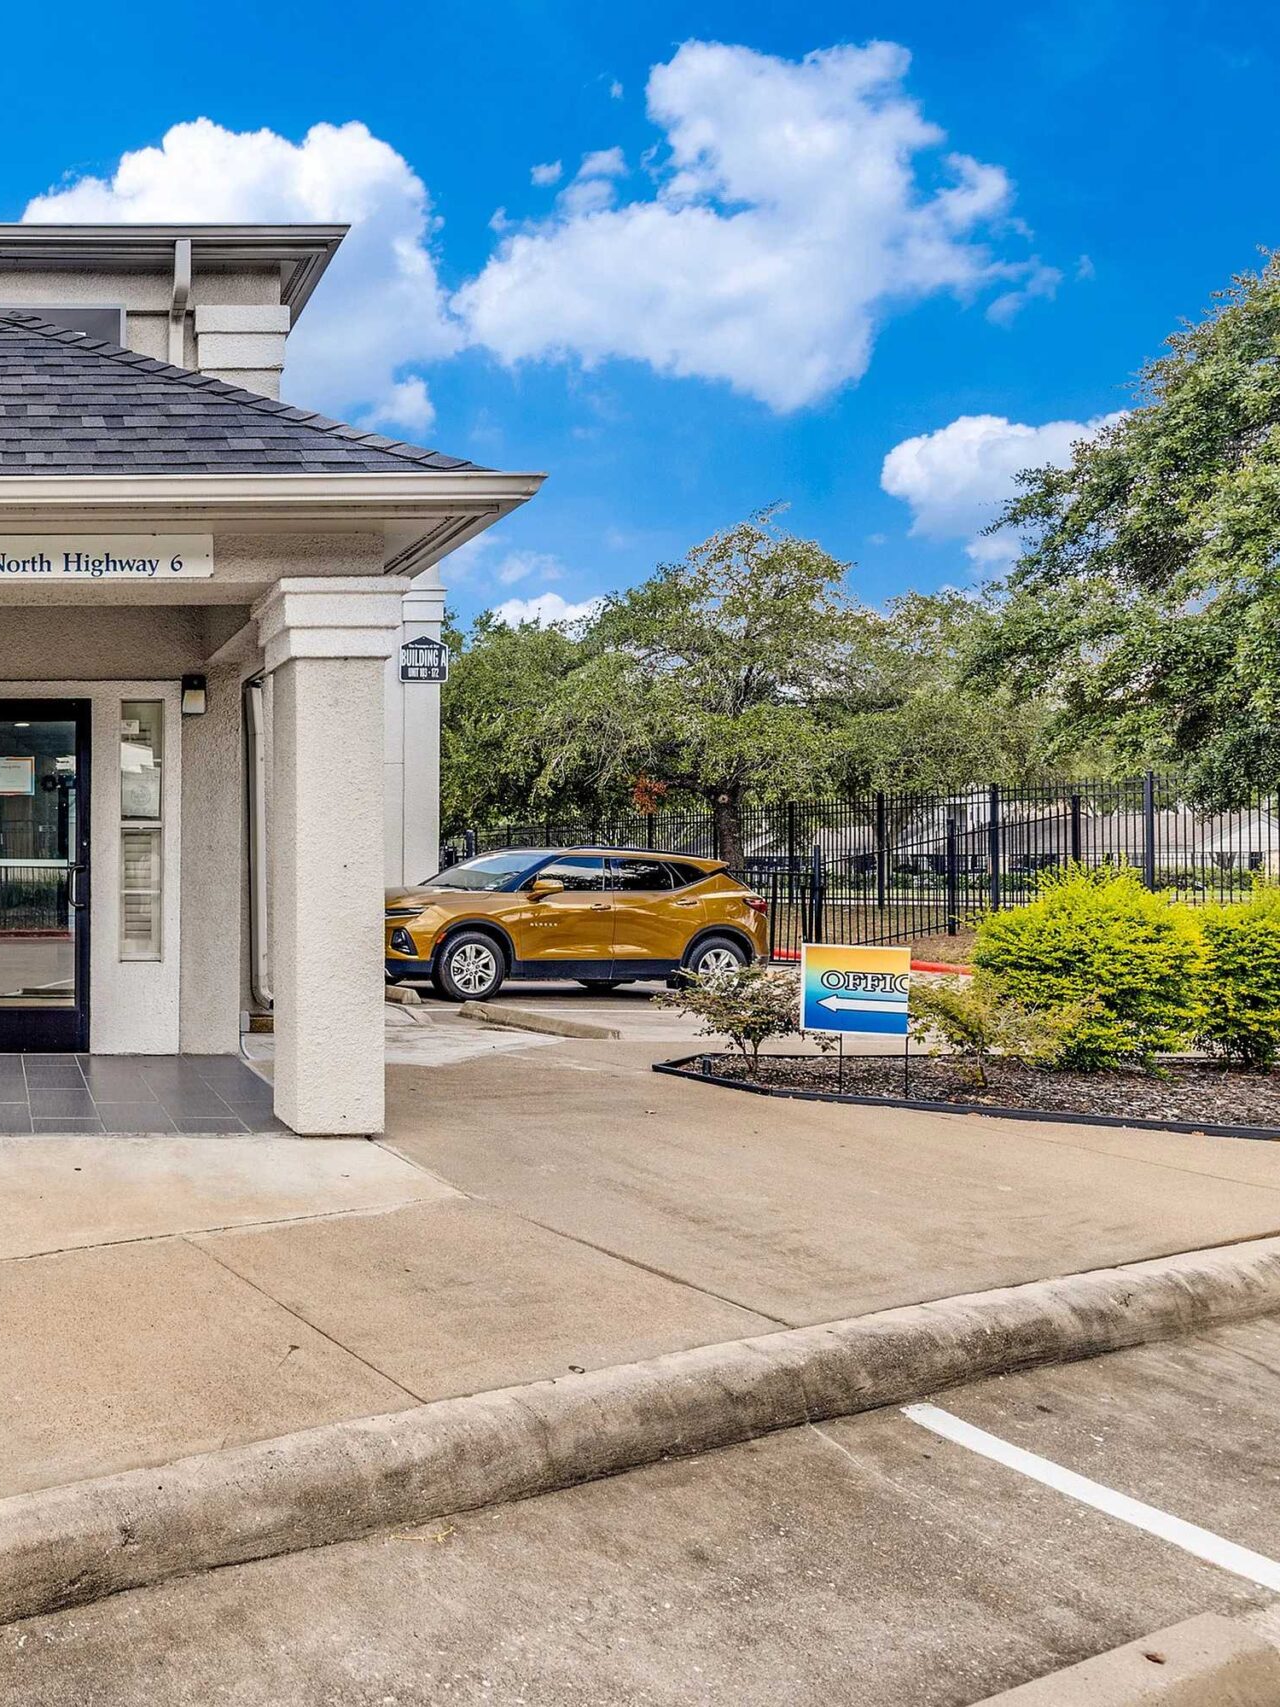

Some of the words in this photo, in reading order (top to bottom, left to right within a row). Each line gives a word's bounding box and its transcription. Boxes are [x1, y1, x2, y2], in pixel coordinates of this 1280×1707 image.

[62, 552, 160, 577] Highway
[170, 552, 184, 573] 6
[401, 649, 439, 666] BUILDING
[440, 649, 446, 666] A
